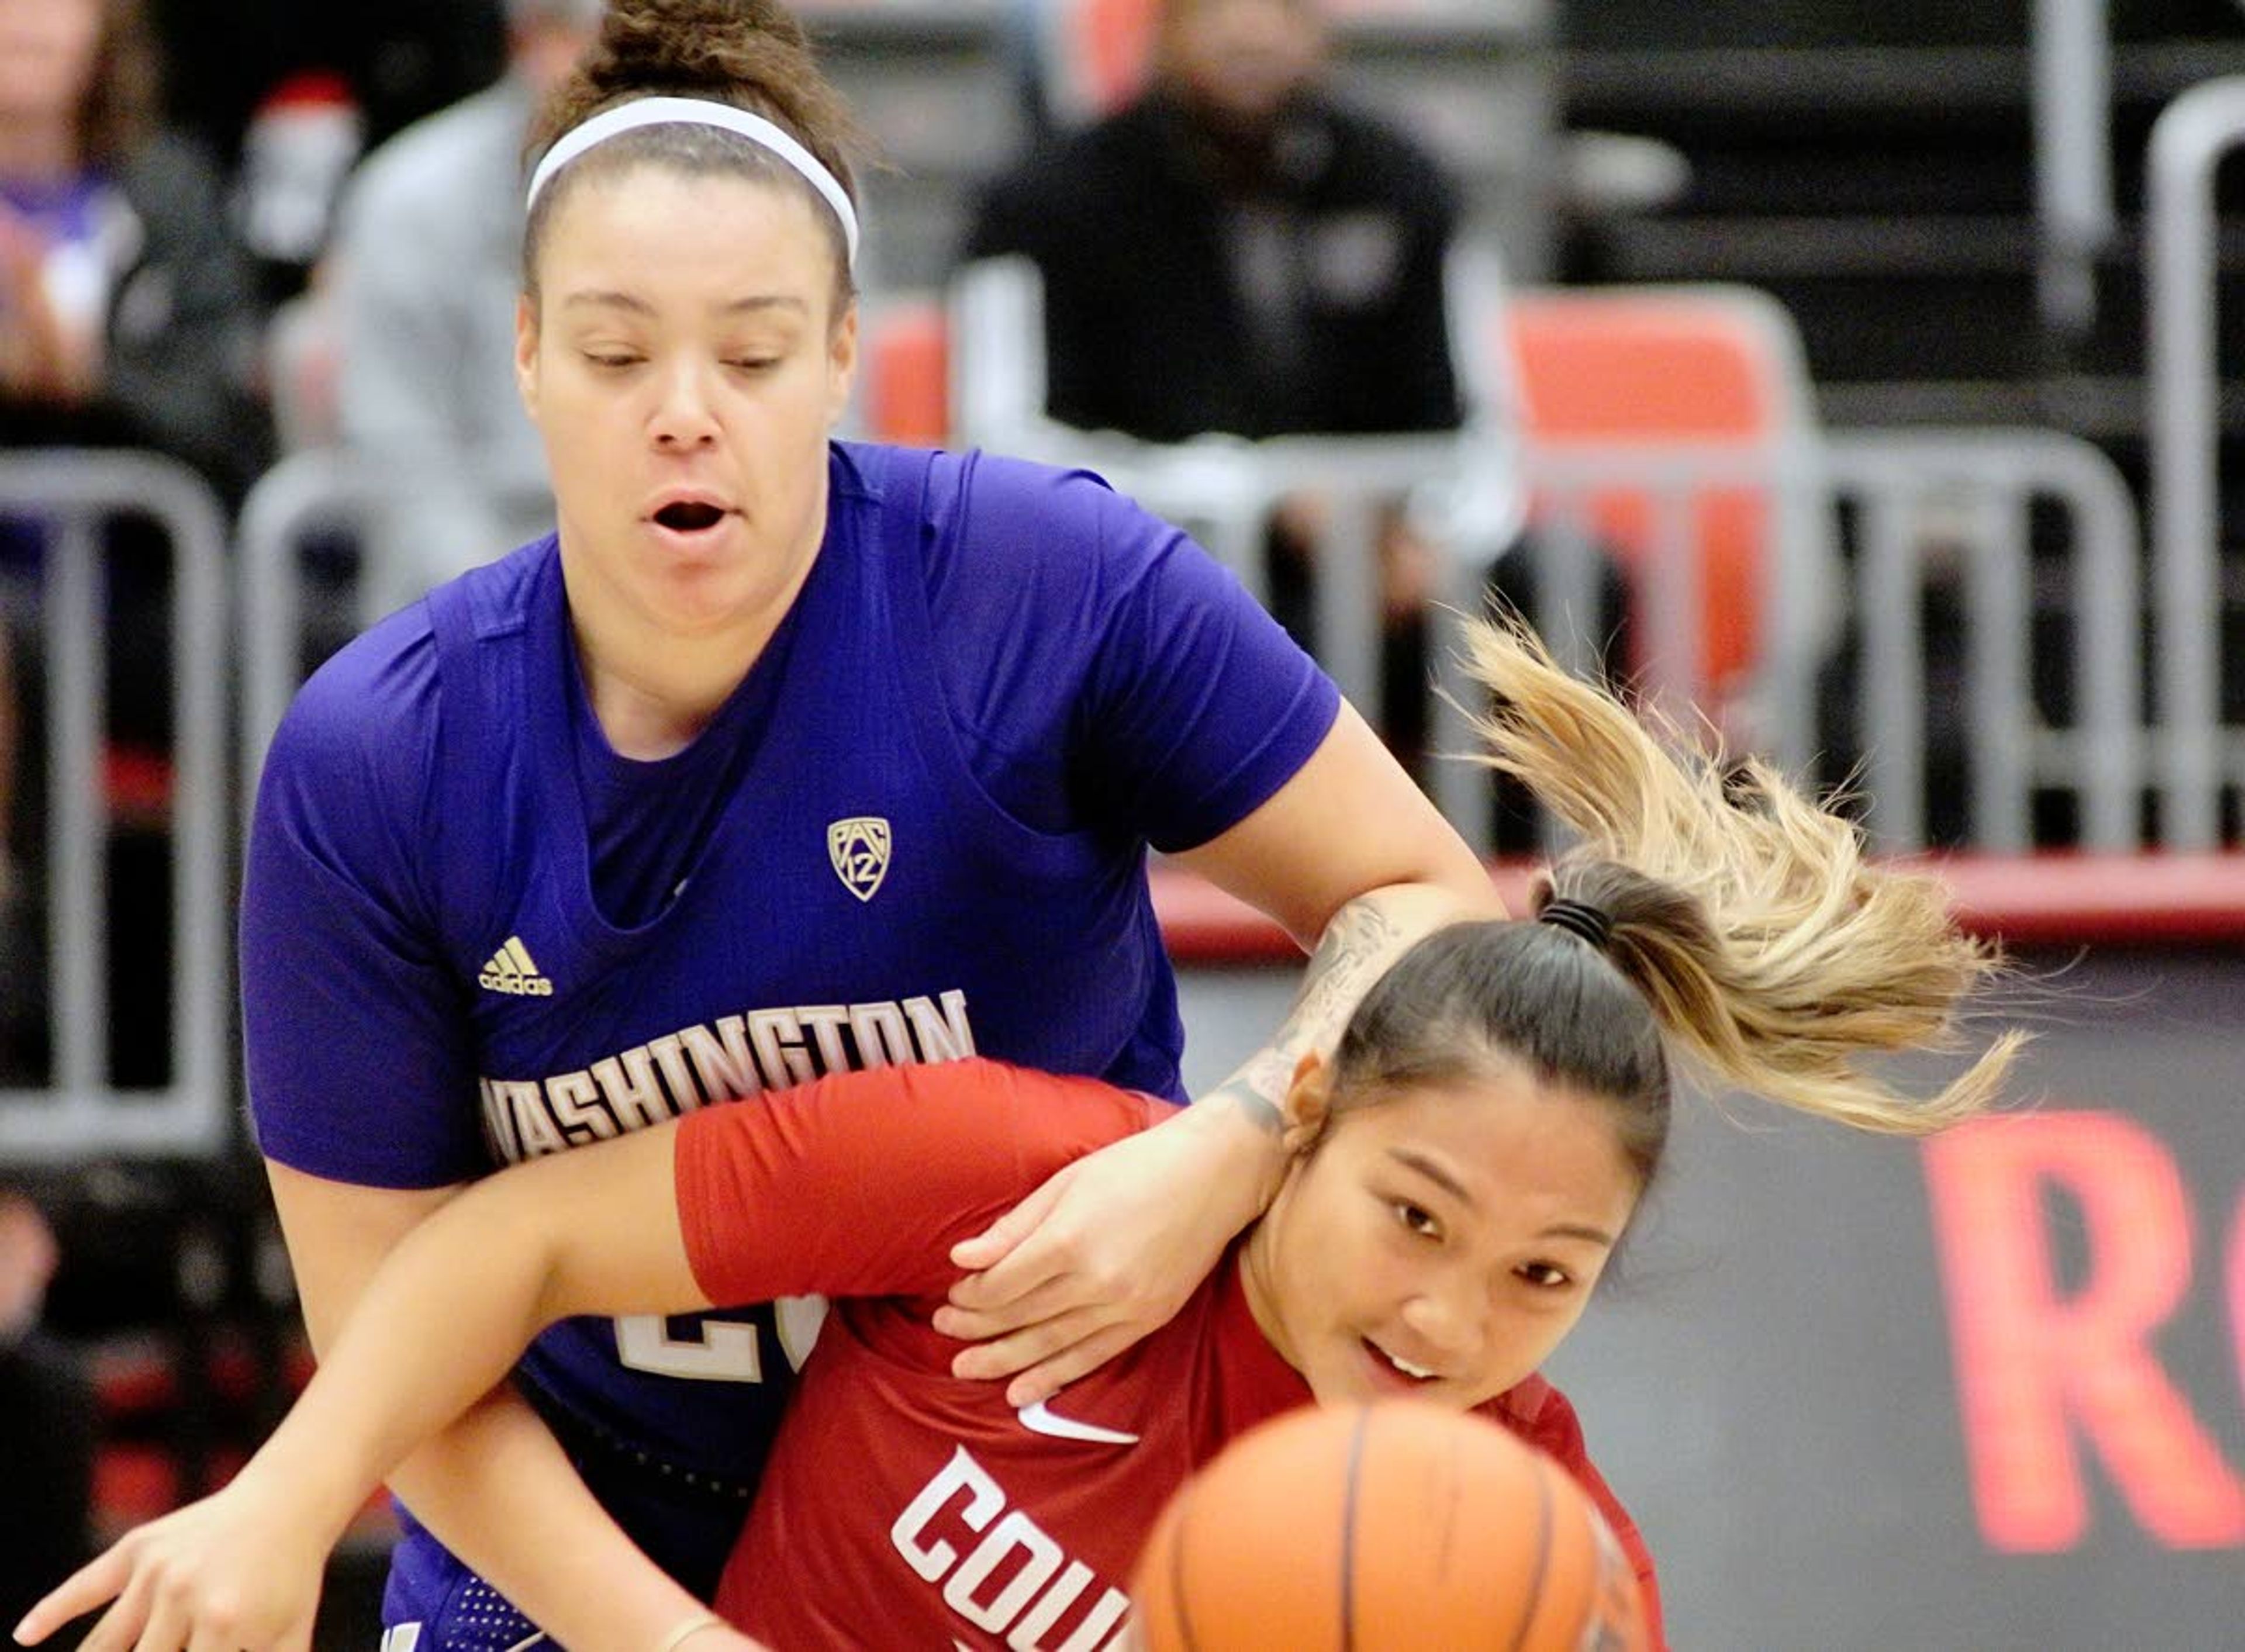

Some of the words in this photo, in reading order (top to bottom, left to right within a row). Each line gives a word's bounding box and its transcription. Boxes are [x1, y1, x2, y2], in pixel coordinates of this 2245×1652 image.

[829, 821, 886, 869] PAC
[847, 852, 878, 882] 12
[478, 973, 553, 996] adidas
[1919, 1108, 2245, 1553] R
[890, 1442, 1143, 1652] COU
